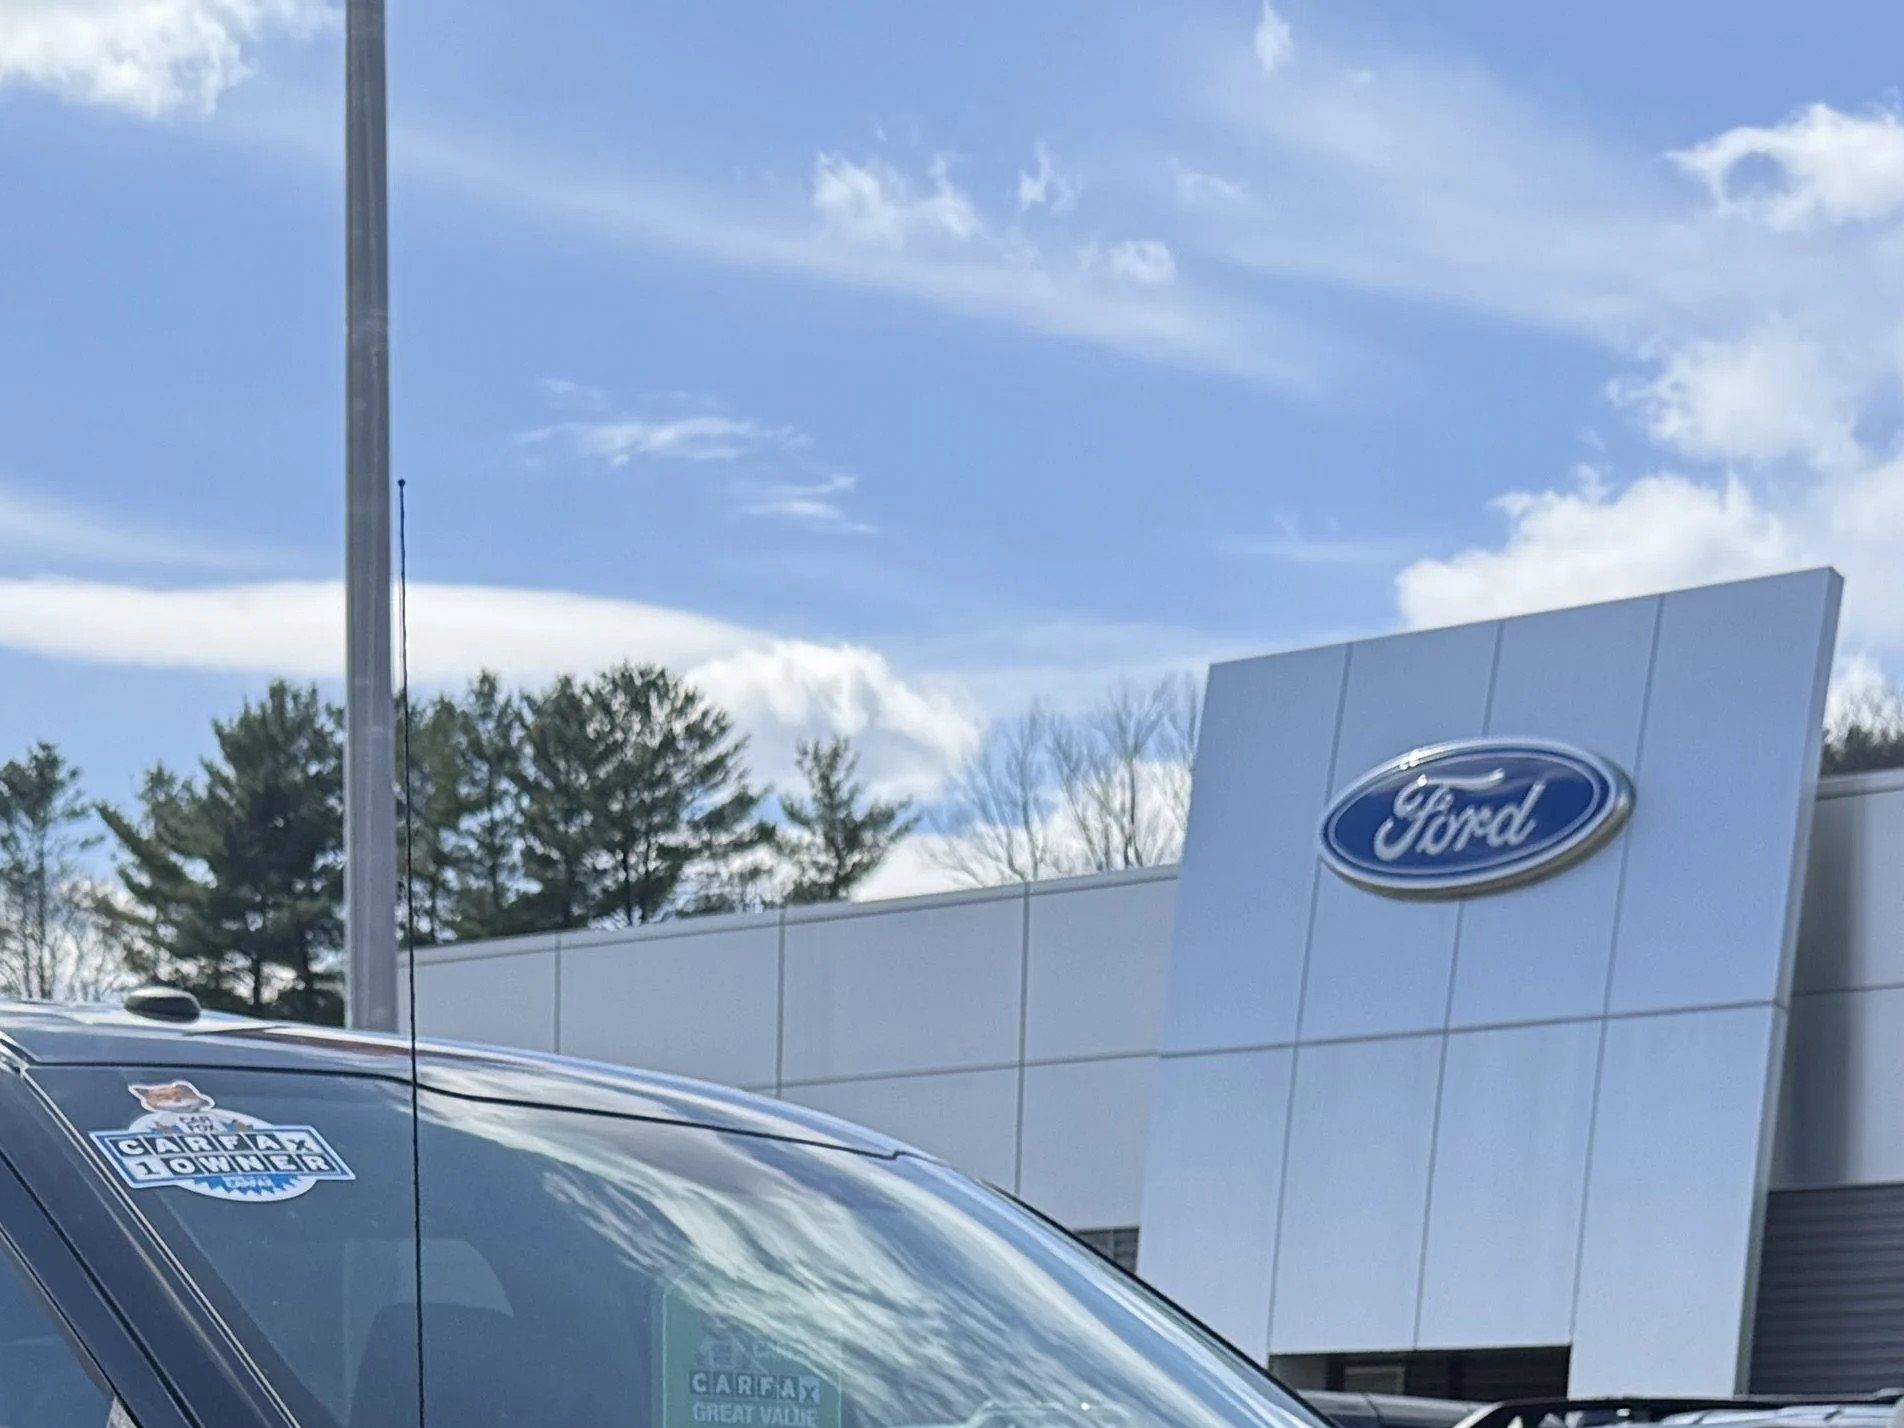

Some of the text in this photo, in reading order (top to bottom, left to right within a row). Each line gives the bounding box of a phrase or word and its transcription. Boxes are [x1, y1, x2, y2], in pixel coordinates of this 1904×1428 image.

[1373, 768, 1546, 862] Ford
[118, 1133, 310, 1155] CARFAX
[134, 1155, 331, 1176] 1 OWNER
[692, 1372, 817, 1403] CARFAX
[692, 1402, 819, 1428] GREAT VALUE
